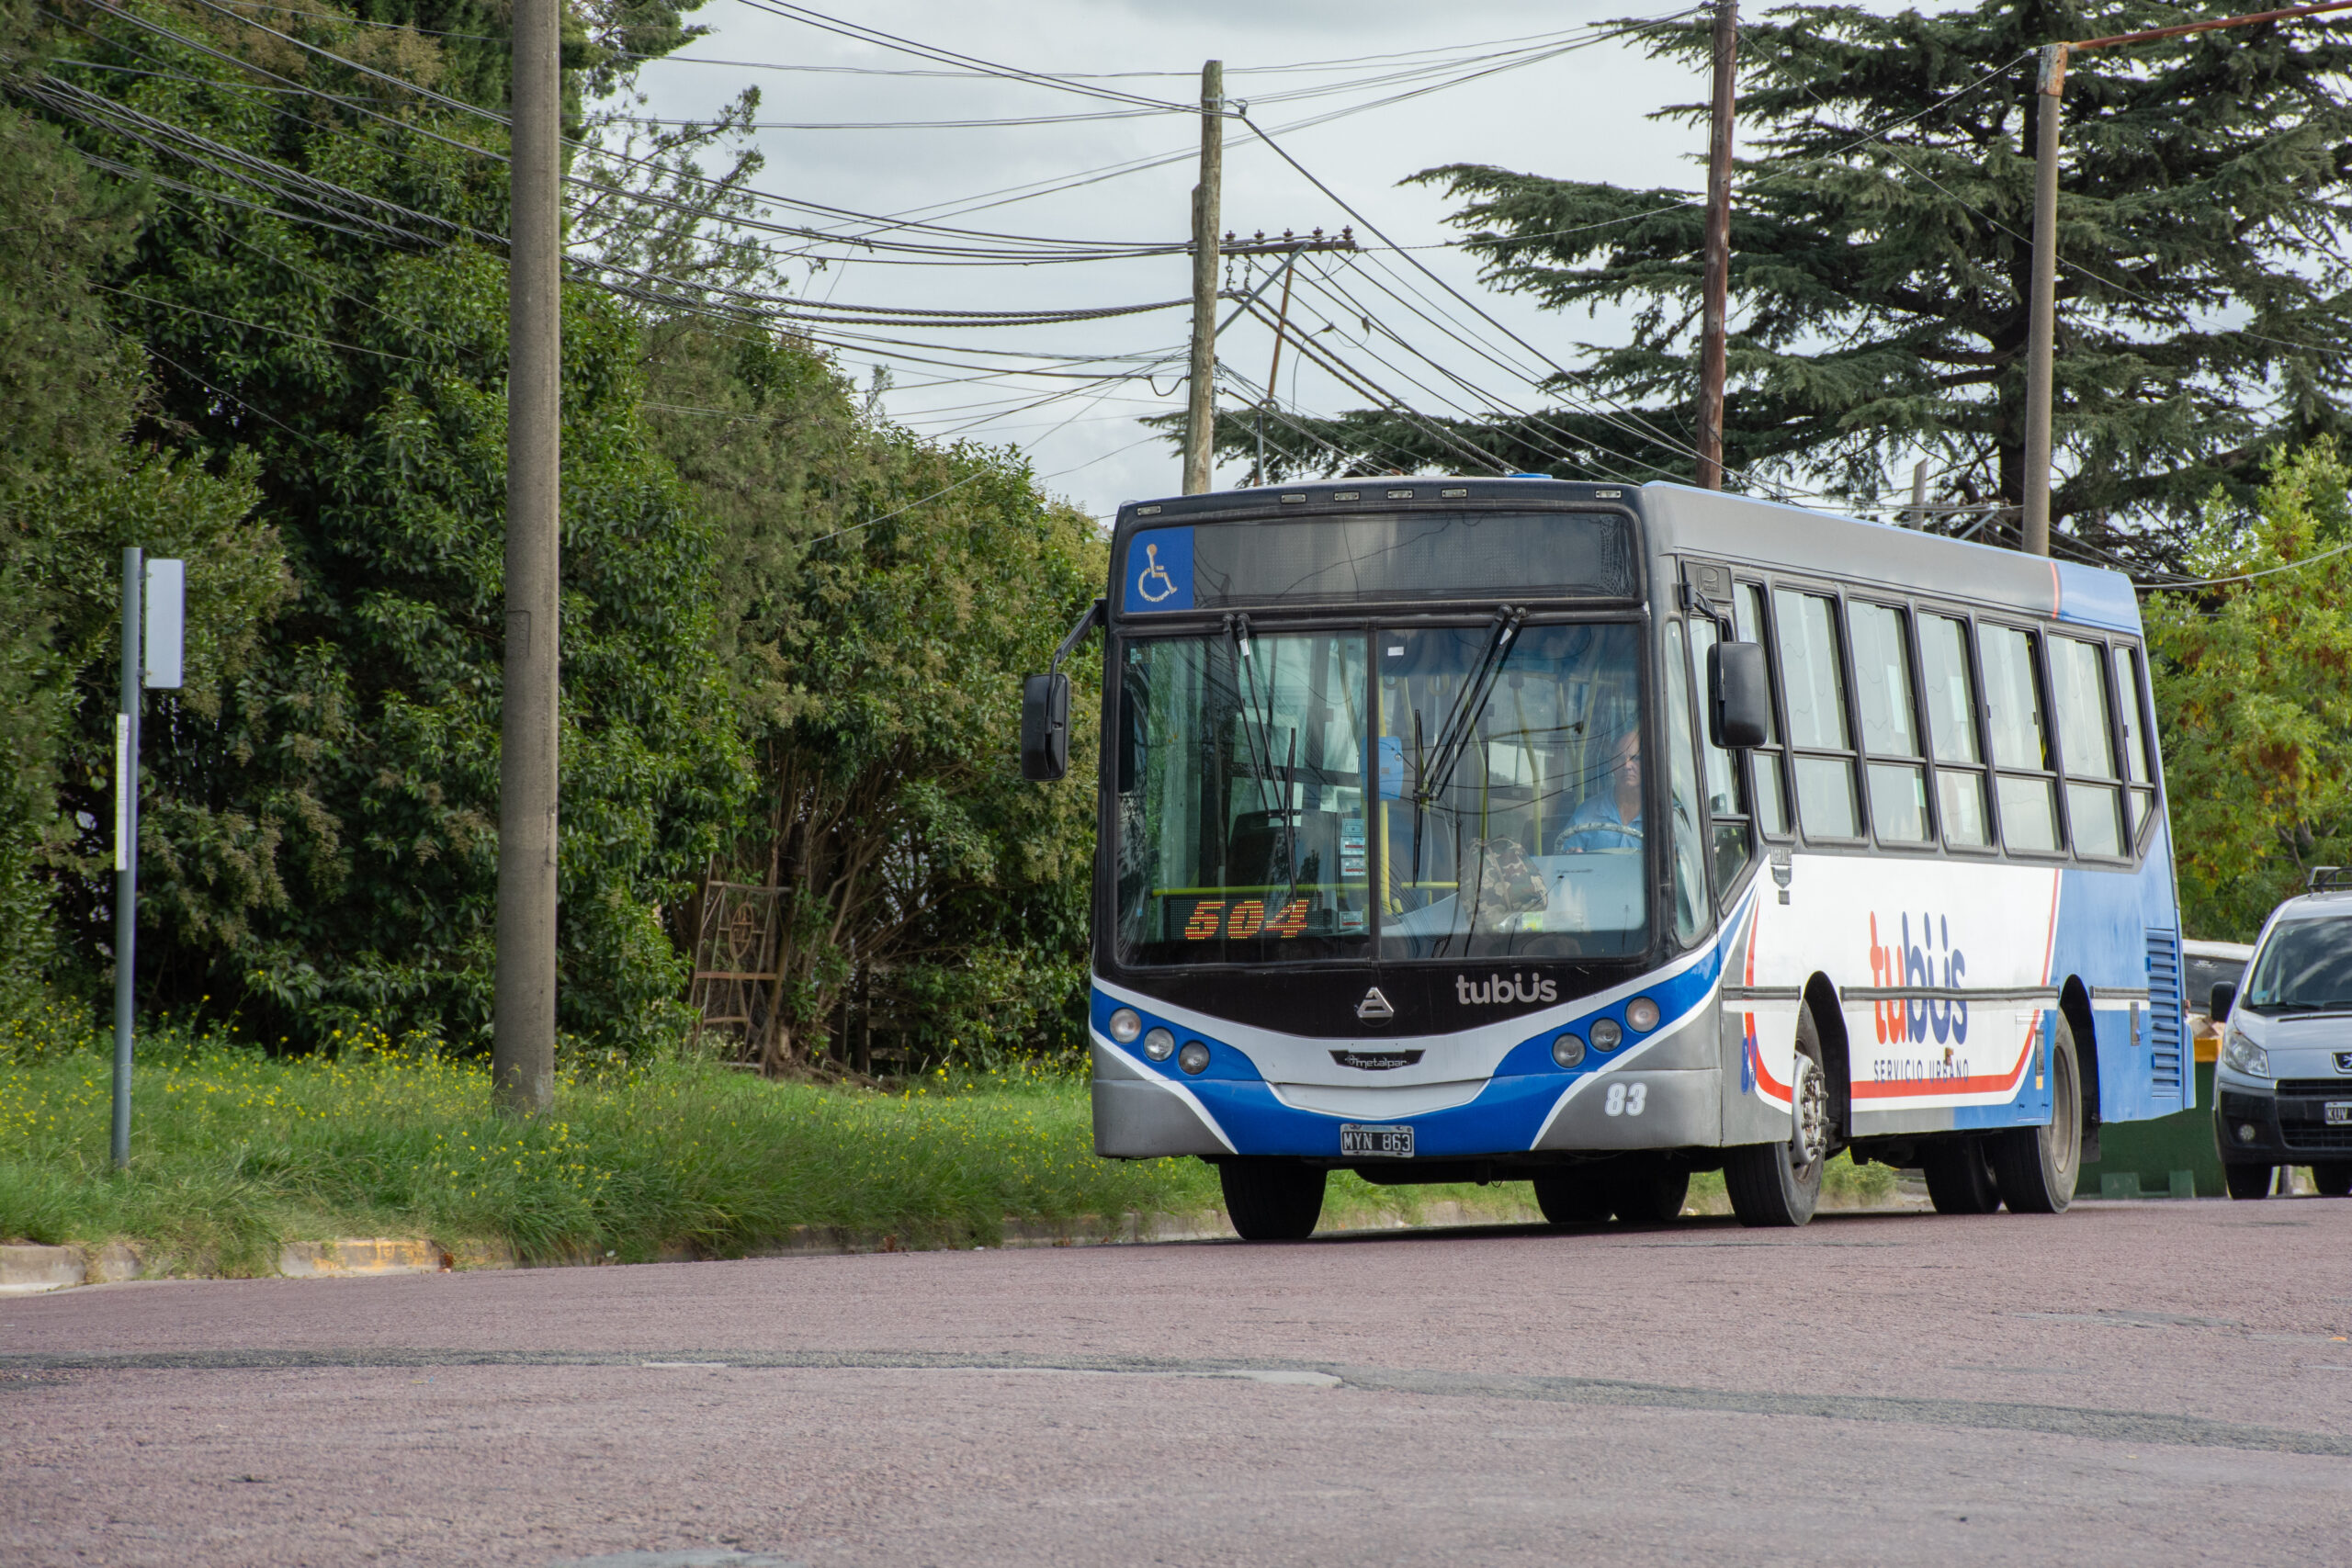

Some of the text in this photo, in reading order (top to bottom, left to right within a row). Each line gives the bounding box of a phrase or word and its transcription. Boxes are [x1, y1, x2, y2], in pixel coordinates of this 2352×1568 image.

[1184, 899, 1309, 940] 504
[1354, 1057, 1408, 1069] metalpar
[1740, 1034, 1758, 1095] 83
[1873, 1058, 1969, 1084] SERVICIO URBANO
[1604, 1082, 1647, 1117] 83
[1343, 1132, 1411, 1152] MYN 863
